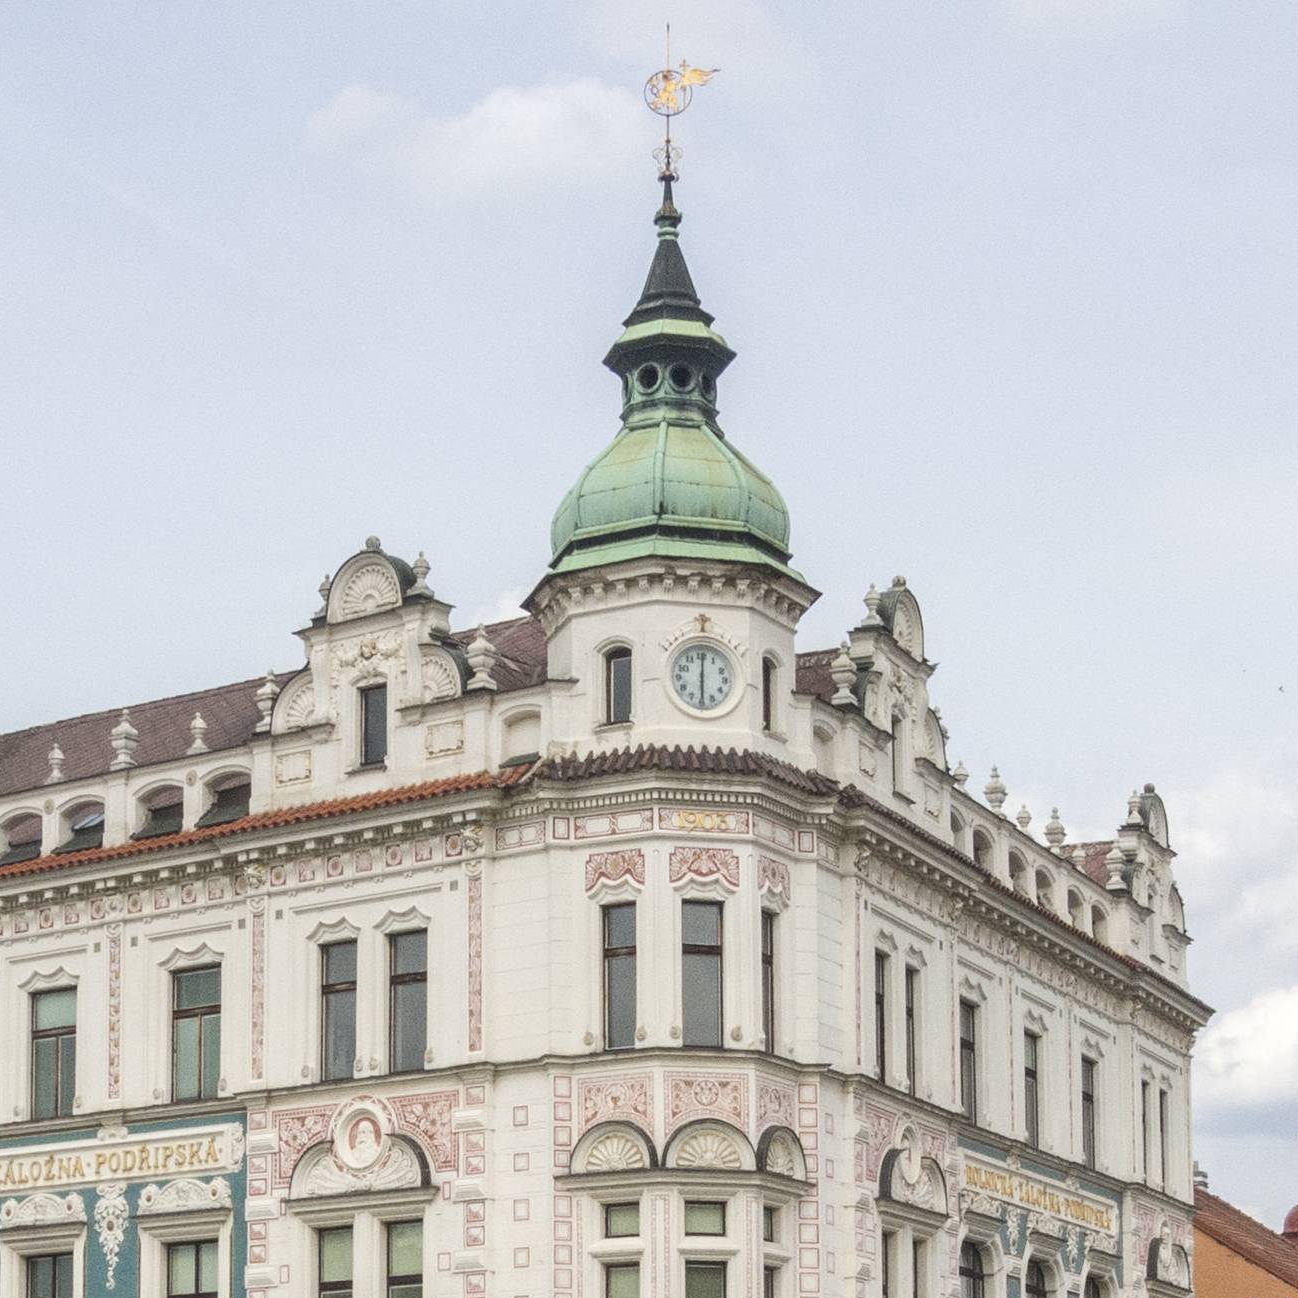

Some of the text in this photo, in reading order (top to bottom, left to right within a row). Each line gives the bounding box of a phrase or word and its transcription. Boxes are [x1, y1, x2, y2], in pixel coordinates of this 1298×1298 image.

[678, 664, 690, 673] 10
[718, 667, 726, 675] 2
[94, 1136, 219, 1175] PODŘIPSKÁ
